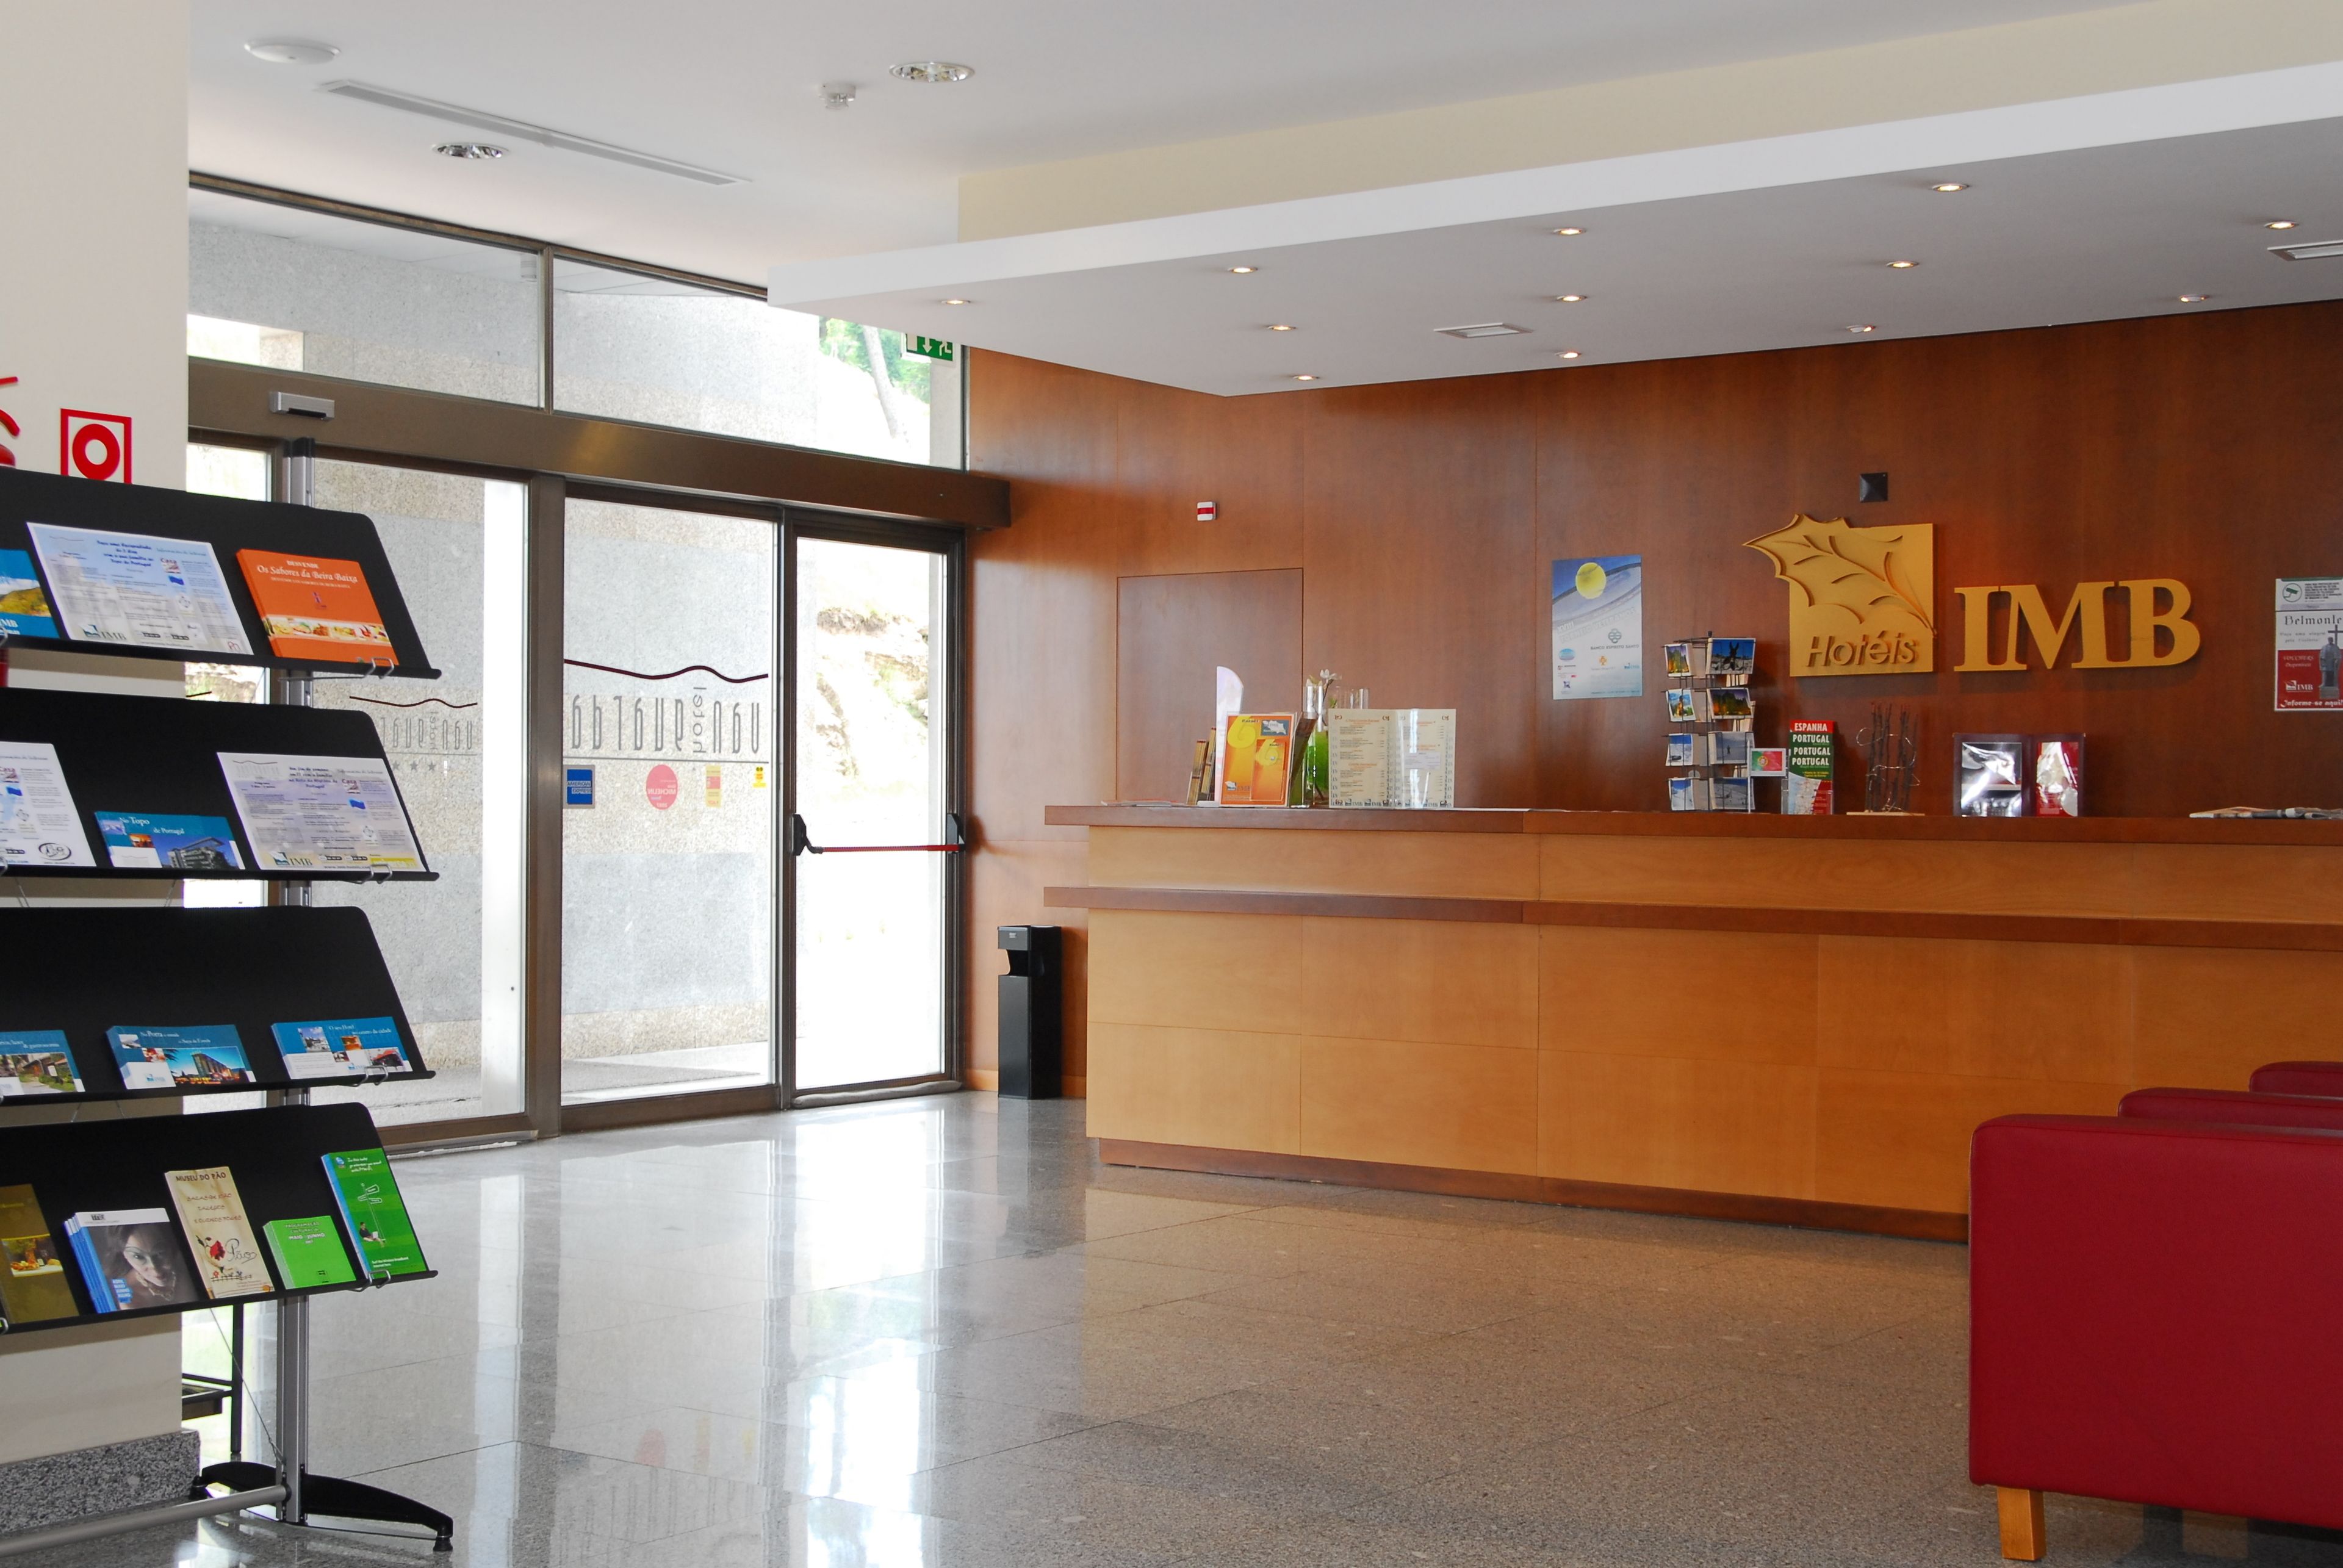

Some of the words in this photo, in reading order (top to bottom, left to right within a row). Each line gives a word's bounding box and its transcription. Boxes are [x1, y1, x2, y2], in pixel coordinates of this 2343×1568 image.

[257, 564, 269, 574] Os
[270, 566, 300, 578] Sabores
[301, 569, 312, 579] da
[312, 570, 334, 581] Beira
[335, 572, 359, 584] Baixa
[2284, 614, 2342, 625] Belmonte
[1954, 578, 2201, 672] IMB
[1807, 630, 1920, 667] Hotéis
[1794, 722, 1828, 732] ESPANHA
[1793, 734, 1830, 743] PORTUGAL
[1793, 747, 1830, 755] PORTUGAL
[1792, 757, 1829, 766] PORTUGAL
[129, 816, 150, 827] Topo
[289, 857, 313, 866] IMB
[212, 1171, 226, 1180] PÃO
